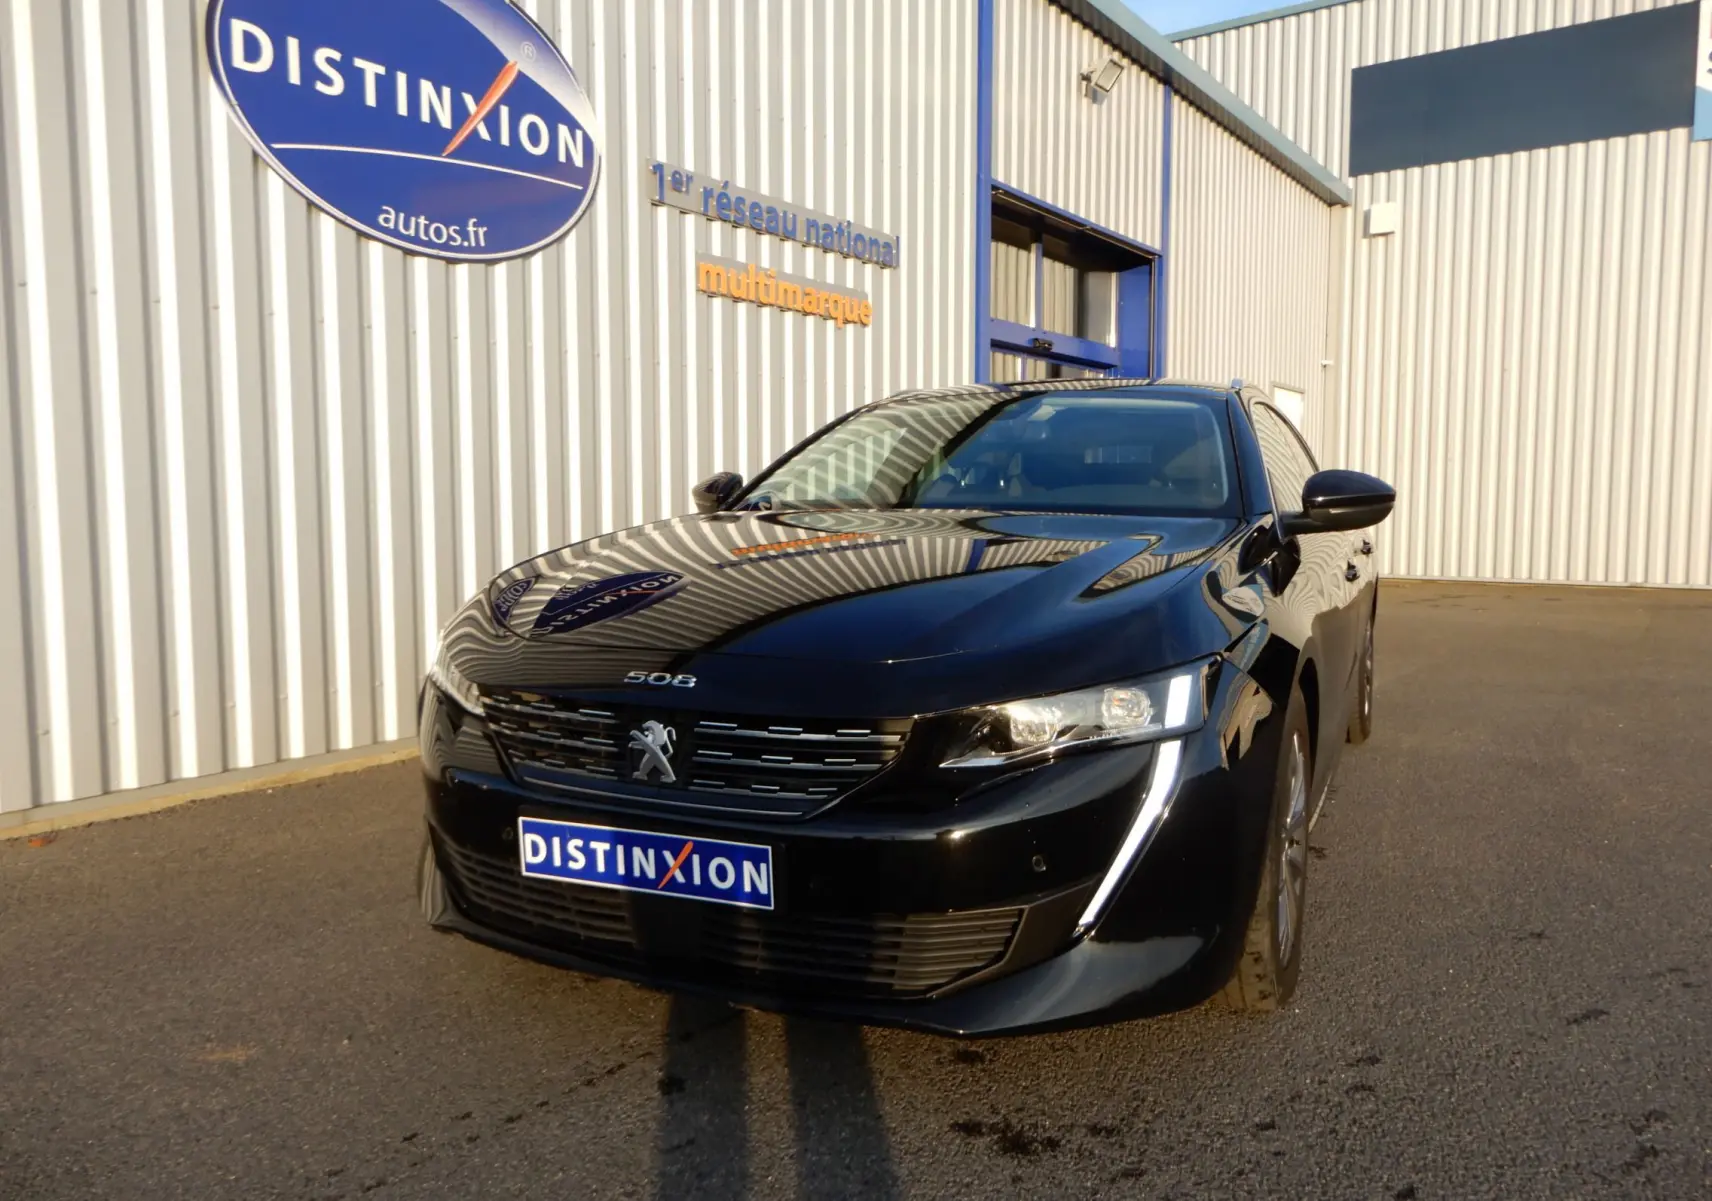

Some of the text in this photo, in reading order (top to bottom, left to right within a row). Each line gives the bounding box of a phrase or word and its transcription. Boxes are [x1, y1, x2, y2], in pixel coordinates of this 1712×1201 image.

[229, 18, 584, 168] DISTINXION
[377, 205, 488, 248] autos.fr
[651, 162, 900, 268] 1er réseau national
[698, 261, 873, 328] multimarque
[623, 671, 697, 688] 508
[523, 832, 768, 894] DISTINXION
